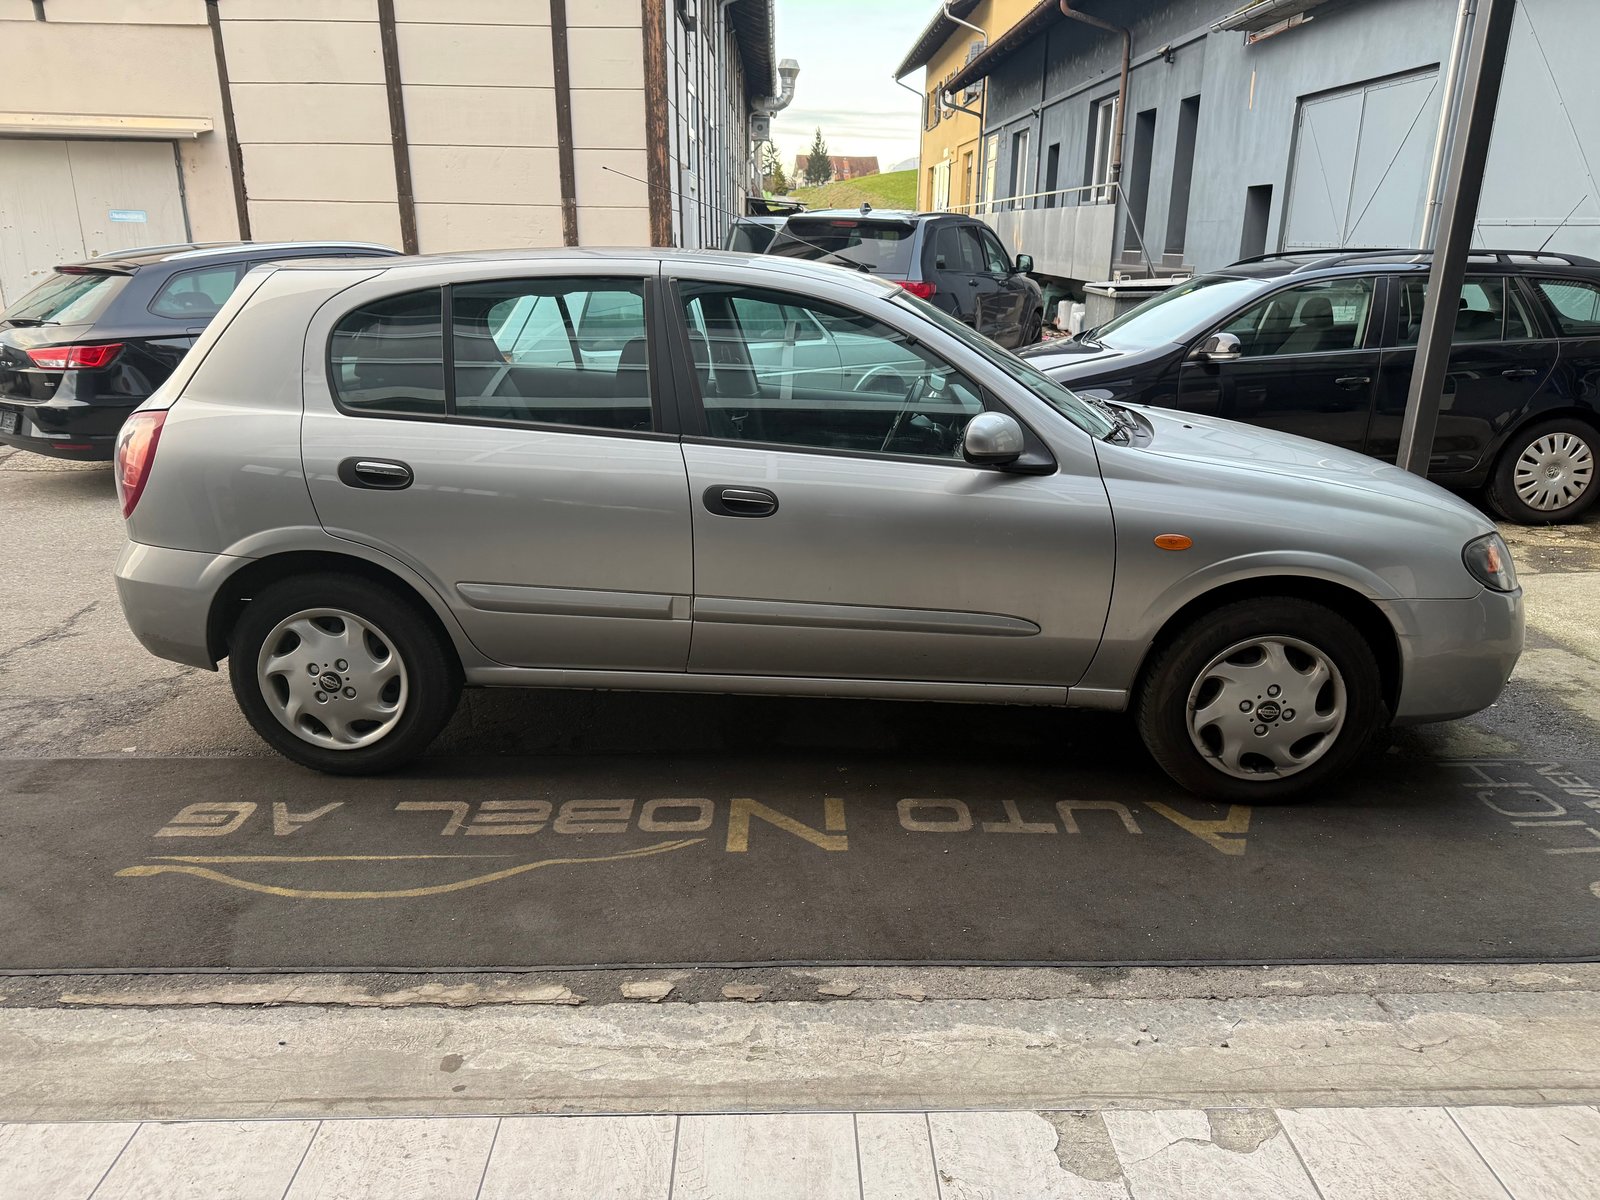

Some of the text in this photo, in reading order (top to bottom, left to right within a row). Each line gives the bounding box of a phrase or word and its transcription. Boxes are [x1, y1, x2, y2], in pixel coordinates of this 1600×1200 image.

[153, 797, 1251, 856] AUTO NOBEL AG
